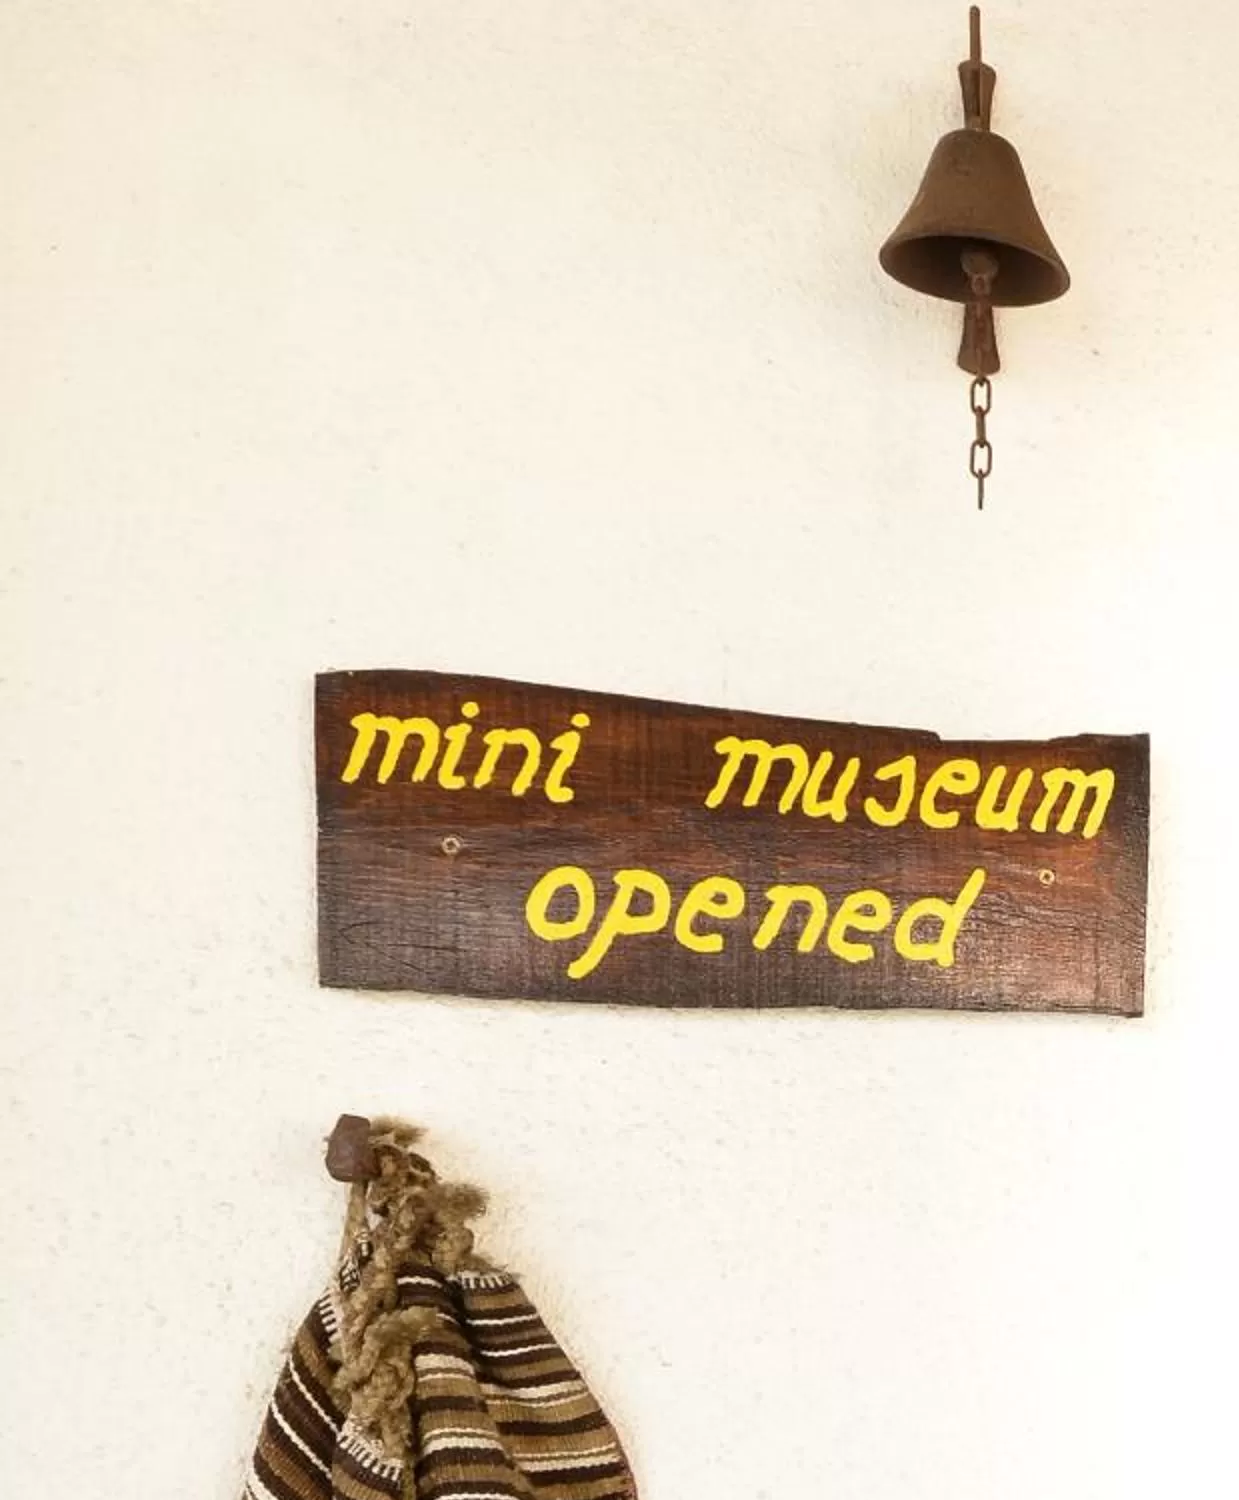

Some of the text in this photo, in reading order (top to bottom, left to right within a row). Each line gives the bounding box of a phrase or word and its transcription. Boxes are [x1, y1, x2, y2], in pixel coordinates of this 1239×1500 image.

[340, 701, 1115, 840] mini museum
[525, 865, 986, 979] opened
